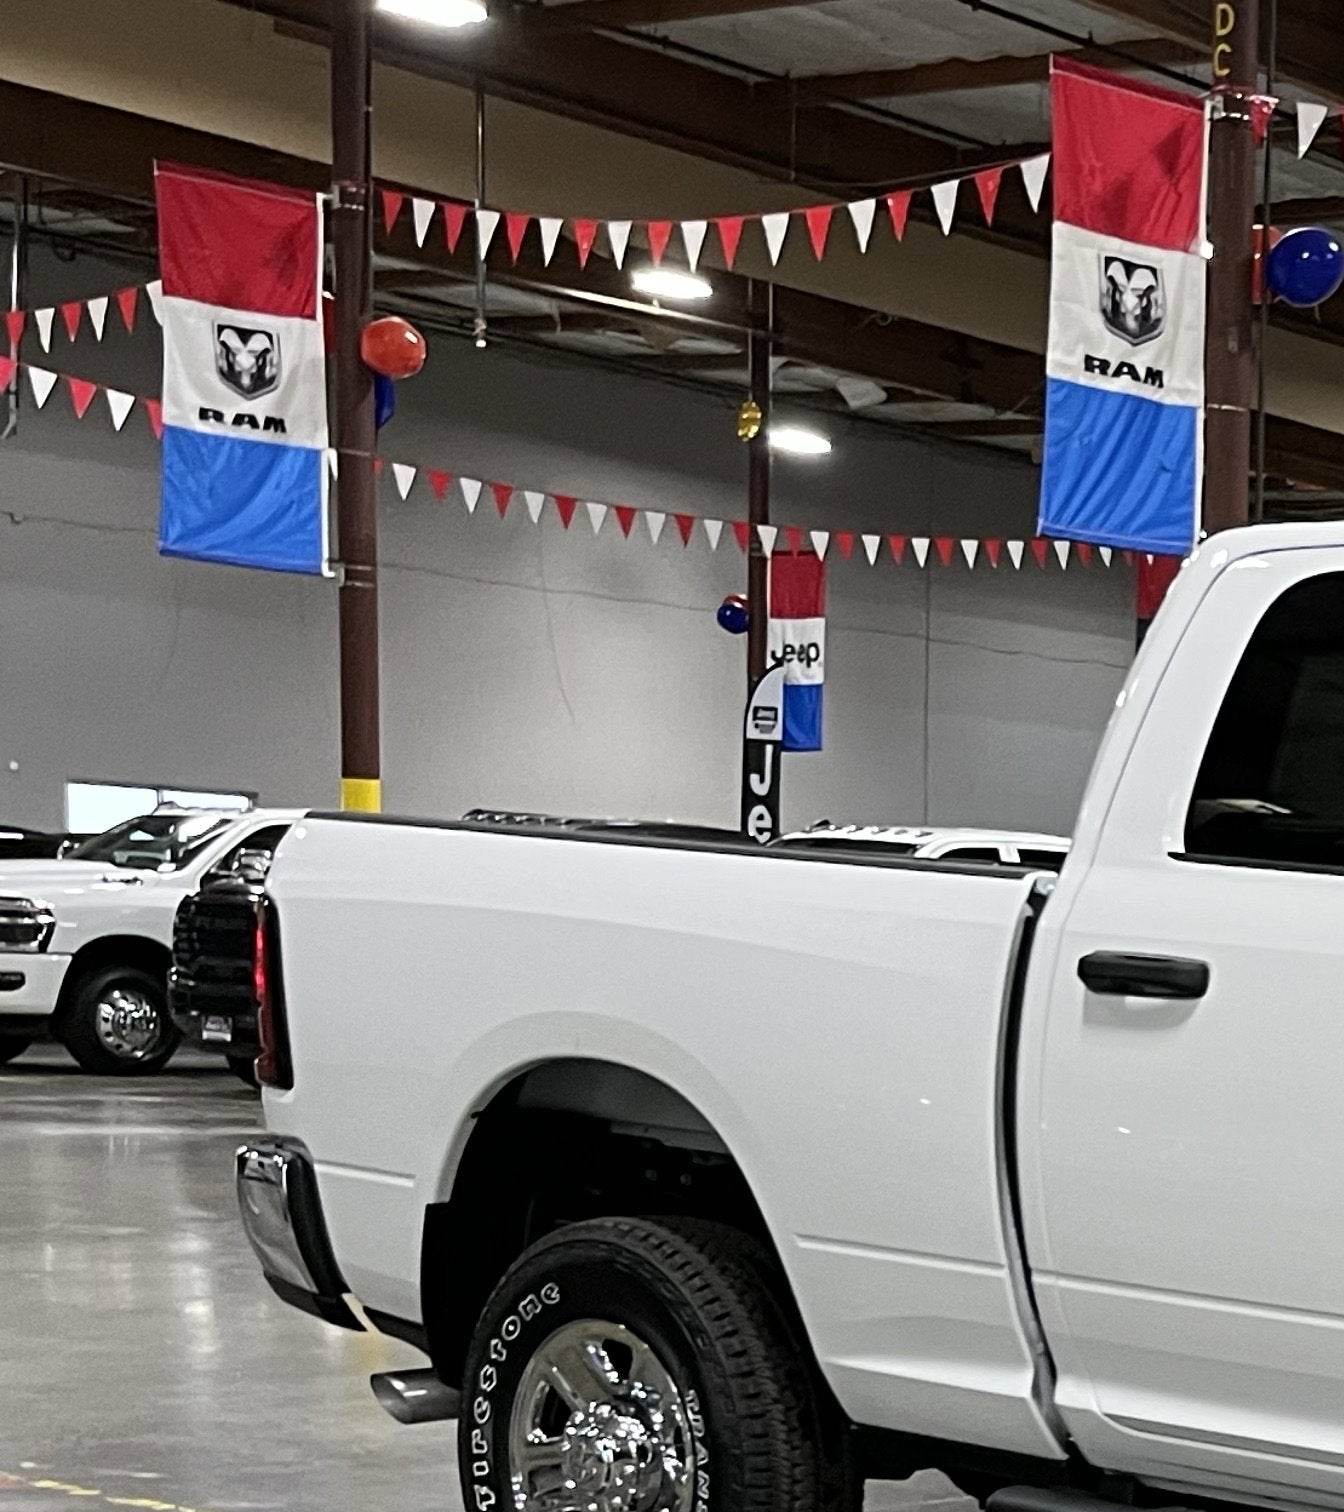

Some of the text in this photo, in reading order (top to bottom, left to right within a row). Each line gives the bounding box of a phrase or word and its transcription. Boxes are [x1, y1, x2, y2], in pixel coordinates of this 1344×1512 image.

[1083, 353, 1164, 390] RAM
[198, 405, 287, 434] RAM
[471, 1282, 561, 1512] Firestone
